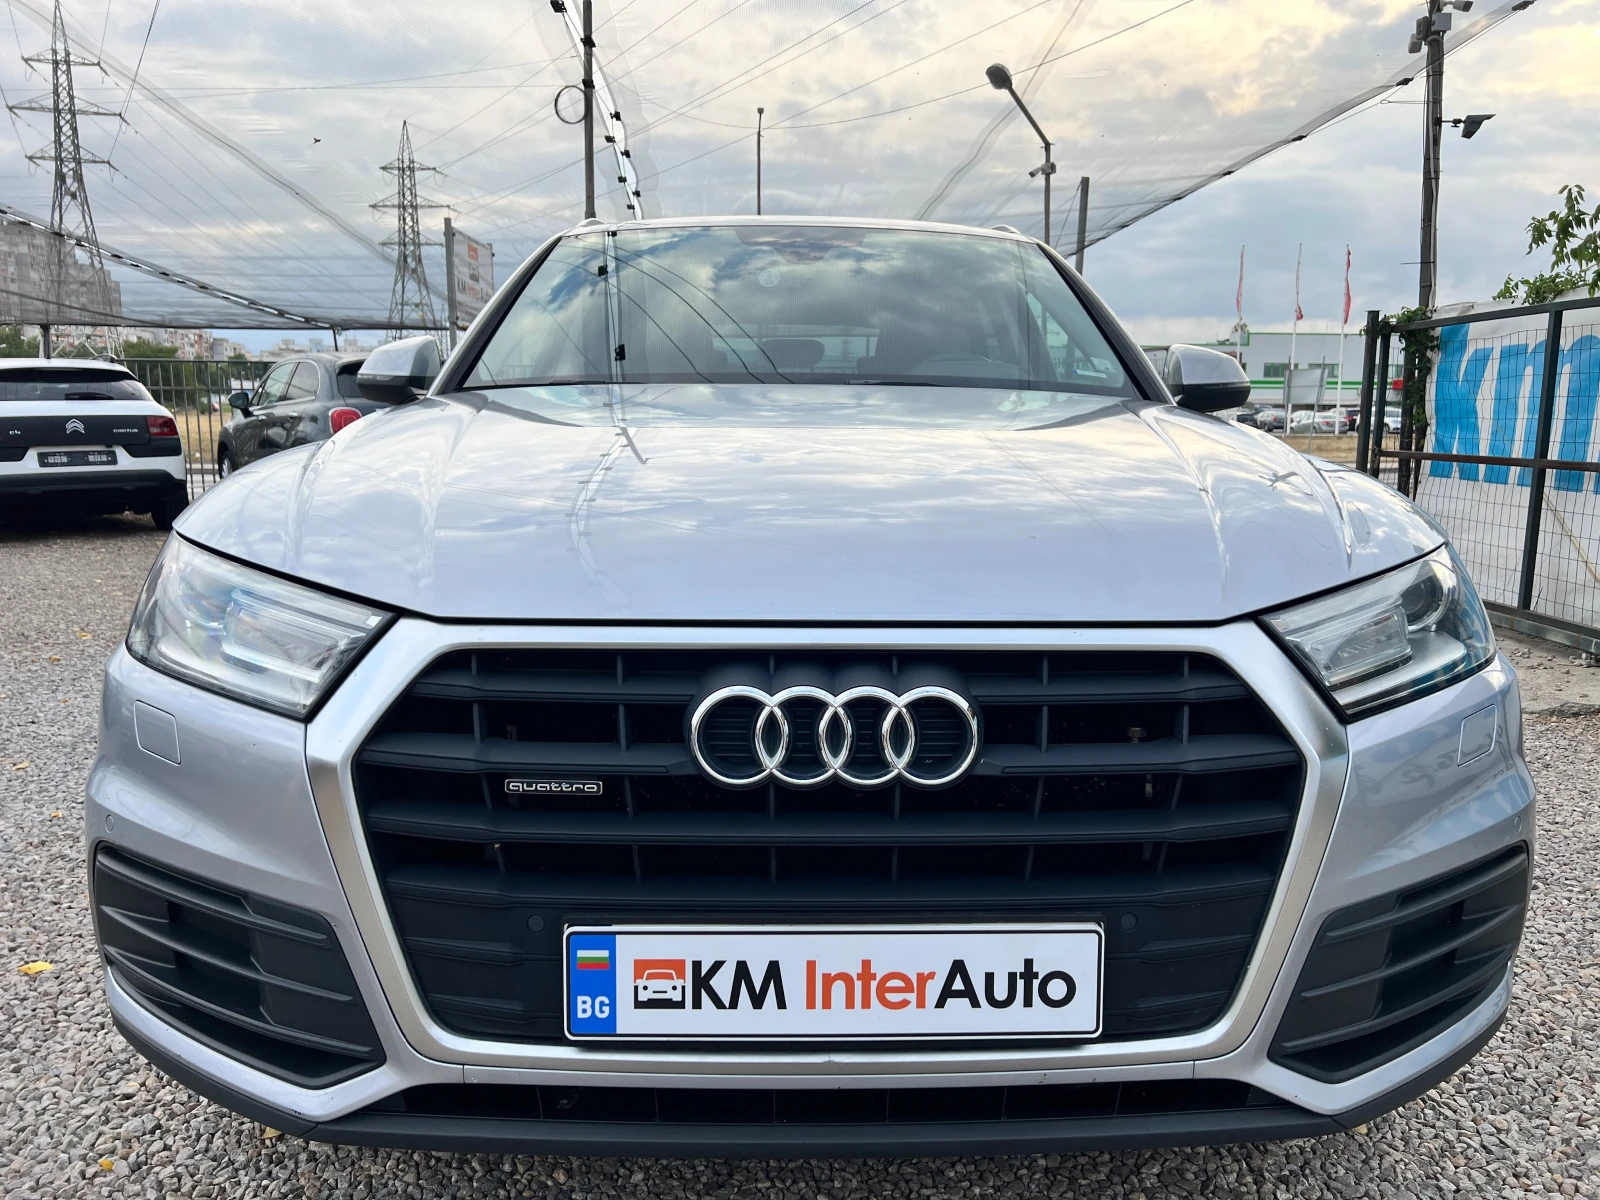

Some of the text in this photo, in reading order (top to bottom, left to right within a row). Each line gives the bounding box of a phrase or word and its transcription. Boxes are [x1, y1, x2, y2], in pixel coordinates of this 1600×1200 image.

[1429, 323, 1600, 494] km
[509, 782, 598, 792] quattro
[691, 958, 1077, 1010] KM InterAuto
[576, 995, 610, 1019] BG
